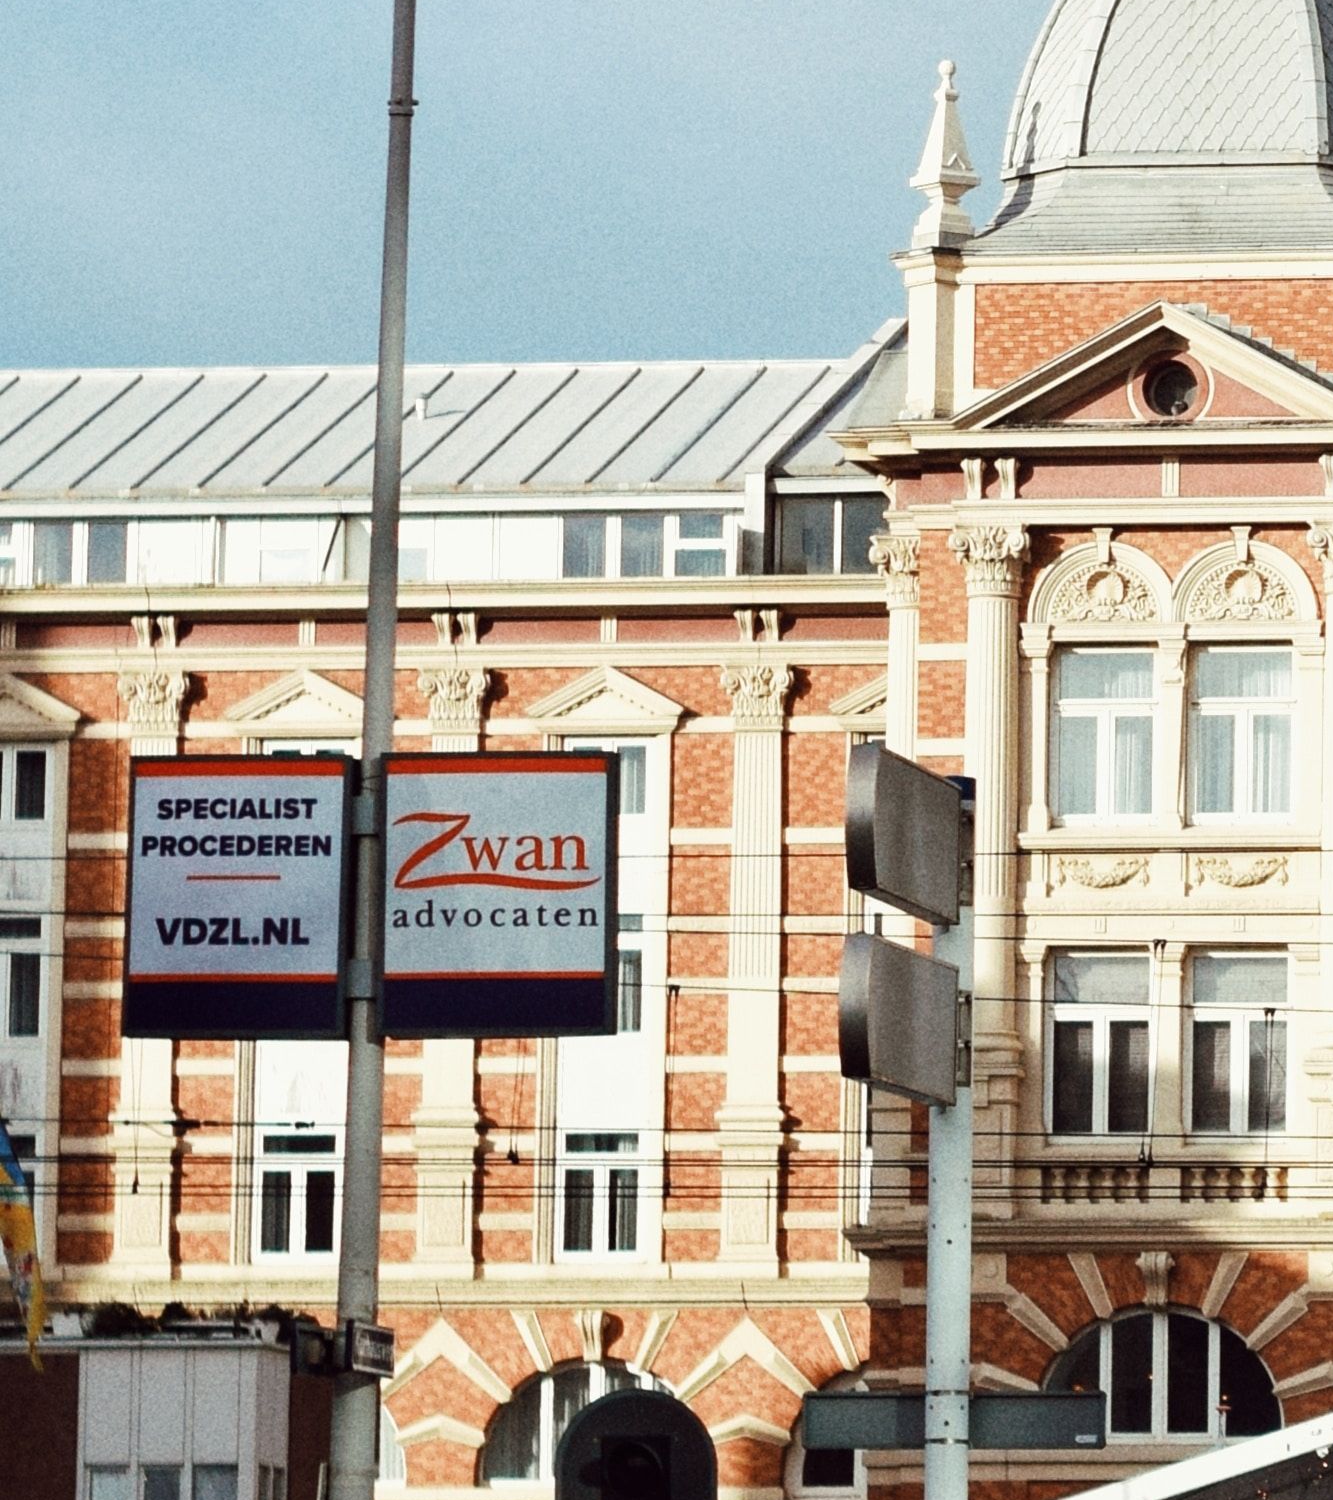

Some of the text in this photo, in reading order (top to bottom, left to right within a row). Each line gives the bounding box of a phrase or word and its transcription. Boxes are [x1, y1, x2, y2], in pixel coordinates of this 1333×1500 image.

[156, 797, 318, 820] SPECIALIST
[140, 834, 332, 857] PROCEDEREN
[393, 811, 602, 891] Zwan
[391, 899, 600, 929] advocaten
[154, 916, 310, 946] VDZL.NL
